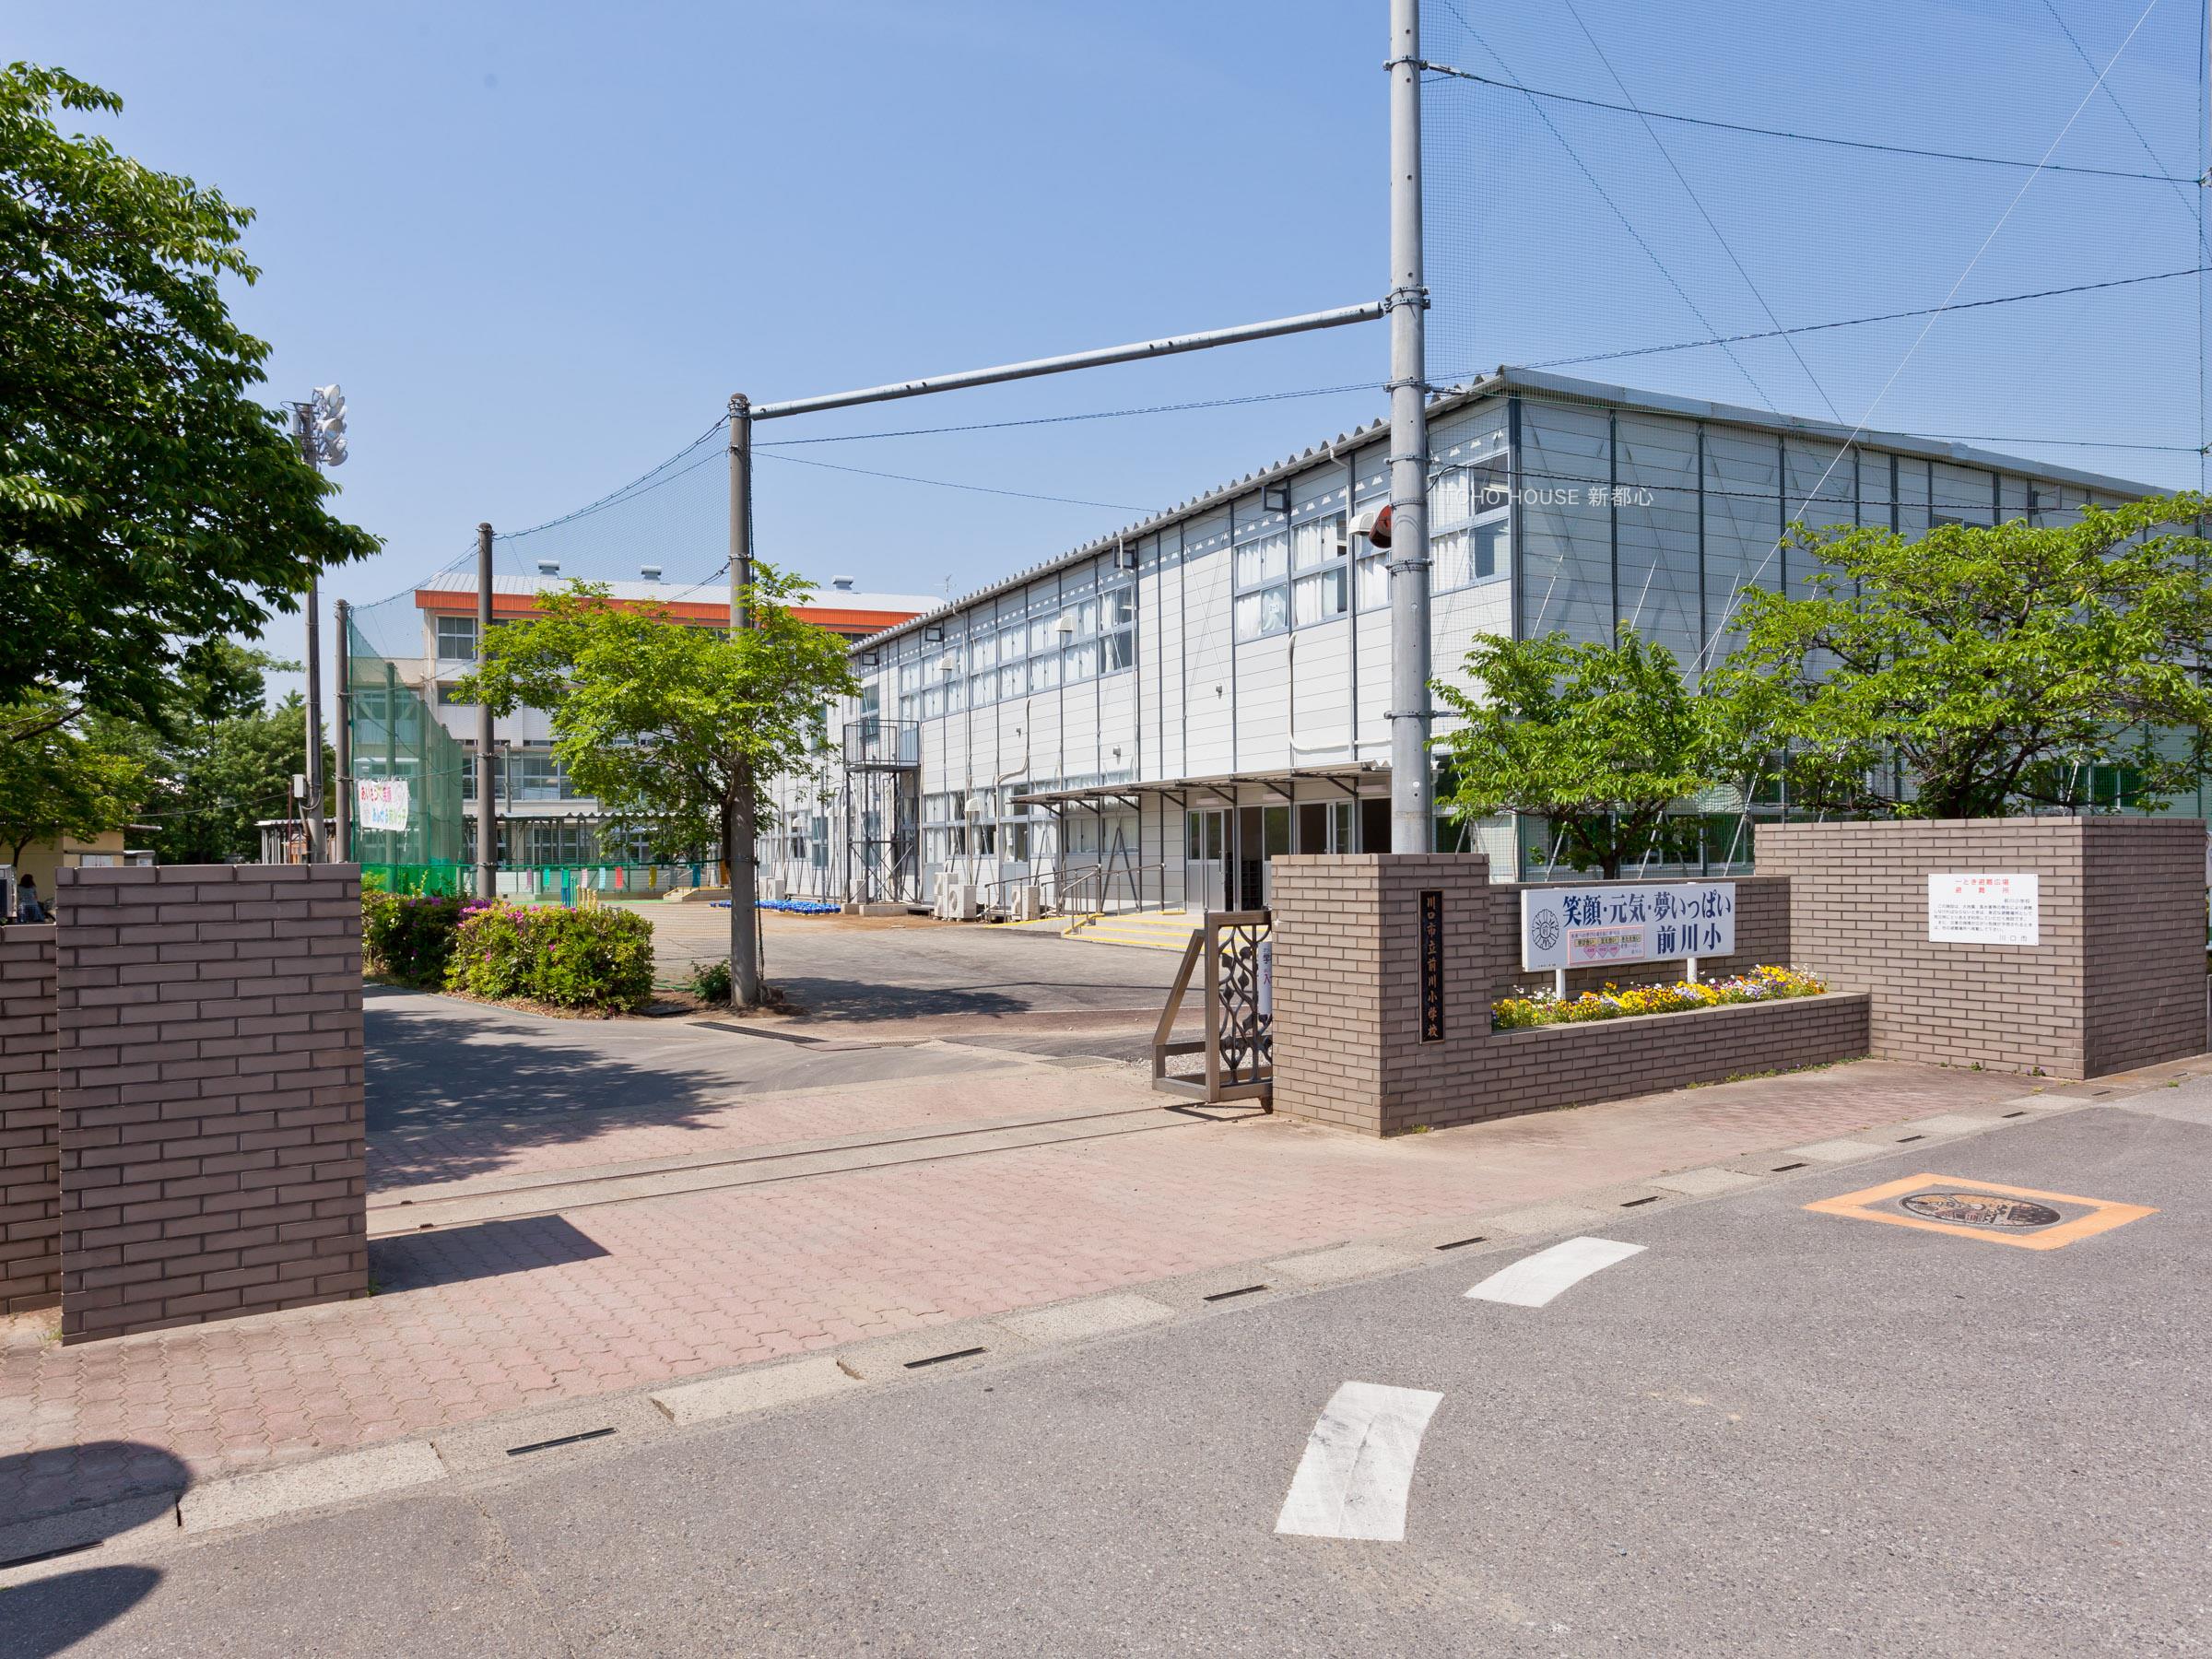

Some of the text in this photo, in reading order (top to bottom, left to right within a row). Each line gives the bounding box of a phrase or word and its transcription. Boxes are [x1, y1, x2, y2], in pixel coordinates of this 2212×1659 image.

[1562, 888, 1731, 928] 笑顔・元気・夢いっぱい
[1656, 923, 1722, 955] 前川小
[1427, 896, 1439, 1039] 川口市立前川小学校
